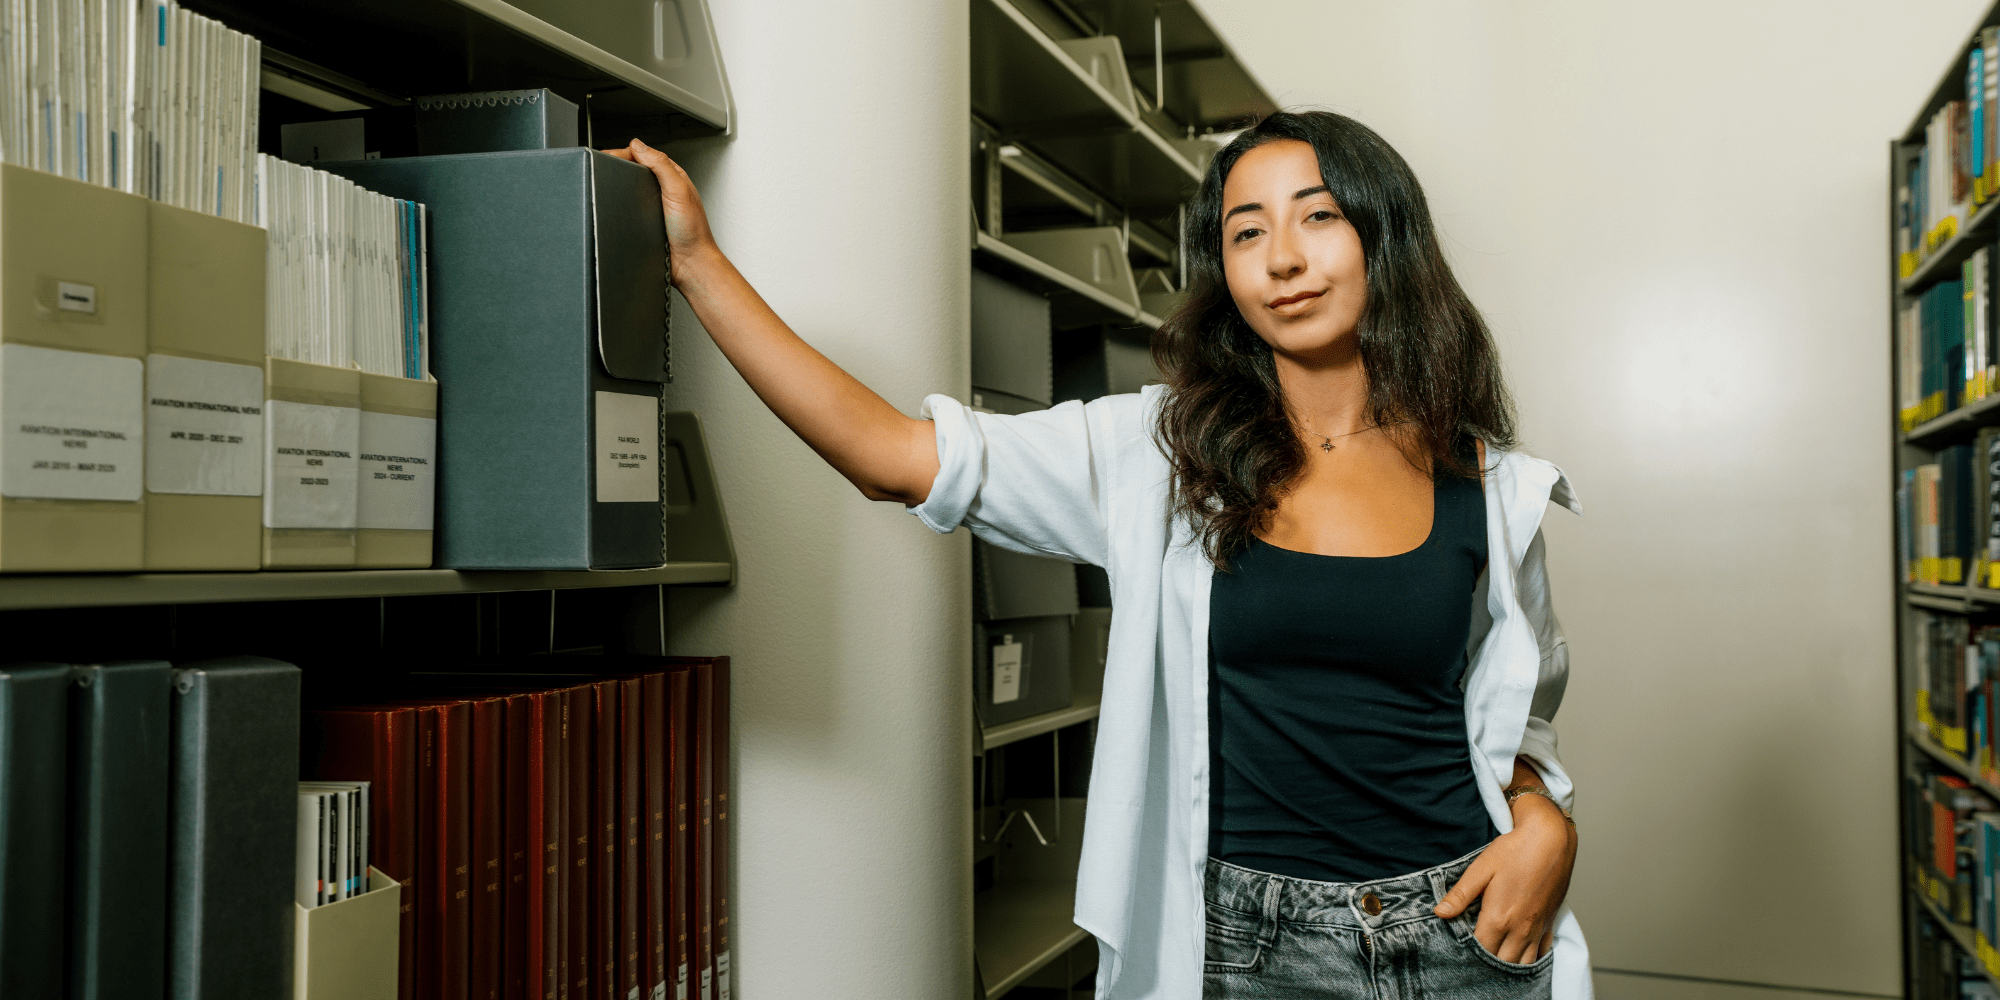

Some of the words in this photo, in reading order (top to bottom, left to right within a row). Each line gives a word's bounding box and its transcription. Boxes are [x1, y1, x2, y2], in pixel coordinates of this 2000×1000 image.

[151, 398, 185, 409] AVIATION
[186, 400, 241, 414] INTERNATIONAL
[241, 406, 261, 415] NEWS
[21, 424, 61, 437] AVIATION
[62, 427, 128, 441] INTERNATIONAL
[62, 439, 88, 449] NEWS
[277, 447, 305, 456] AVIATION
[306, 449, 352, 459] INTERNATIONAL
[306, 458, 324, 466] NEWS
[360, 453, 386, 462] AVIATION
[387, 455, 428, 465] INTERNATIONAL
[387, 464, 403, 472] NEWS
[300, 477, 329, 486] 2022-2023
[373, 472, 387, 480] 2024
[391, 473, 415, 482] CURRENT
